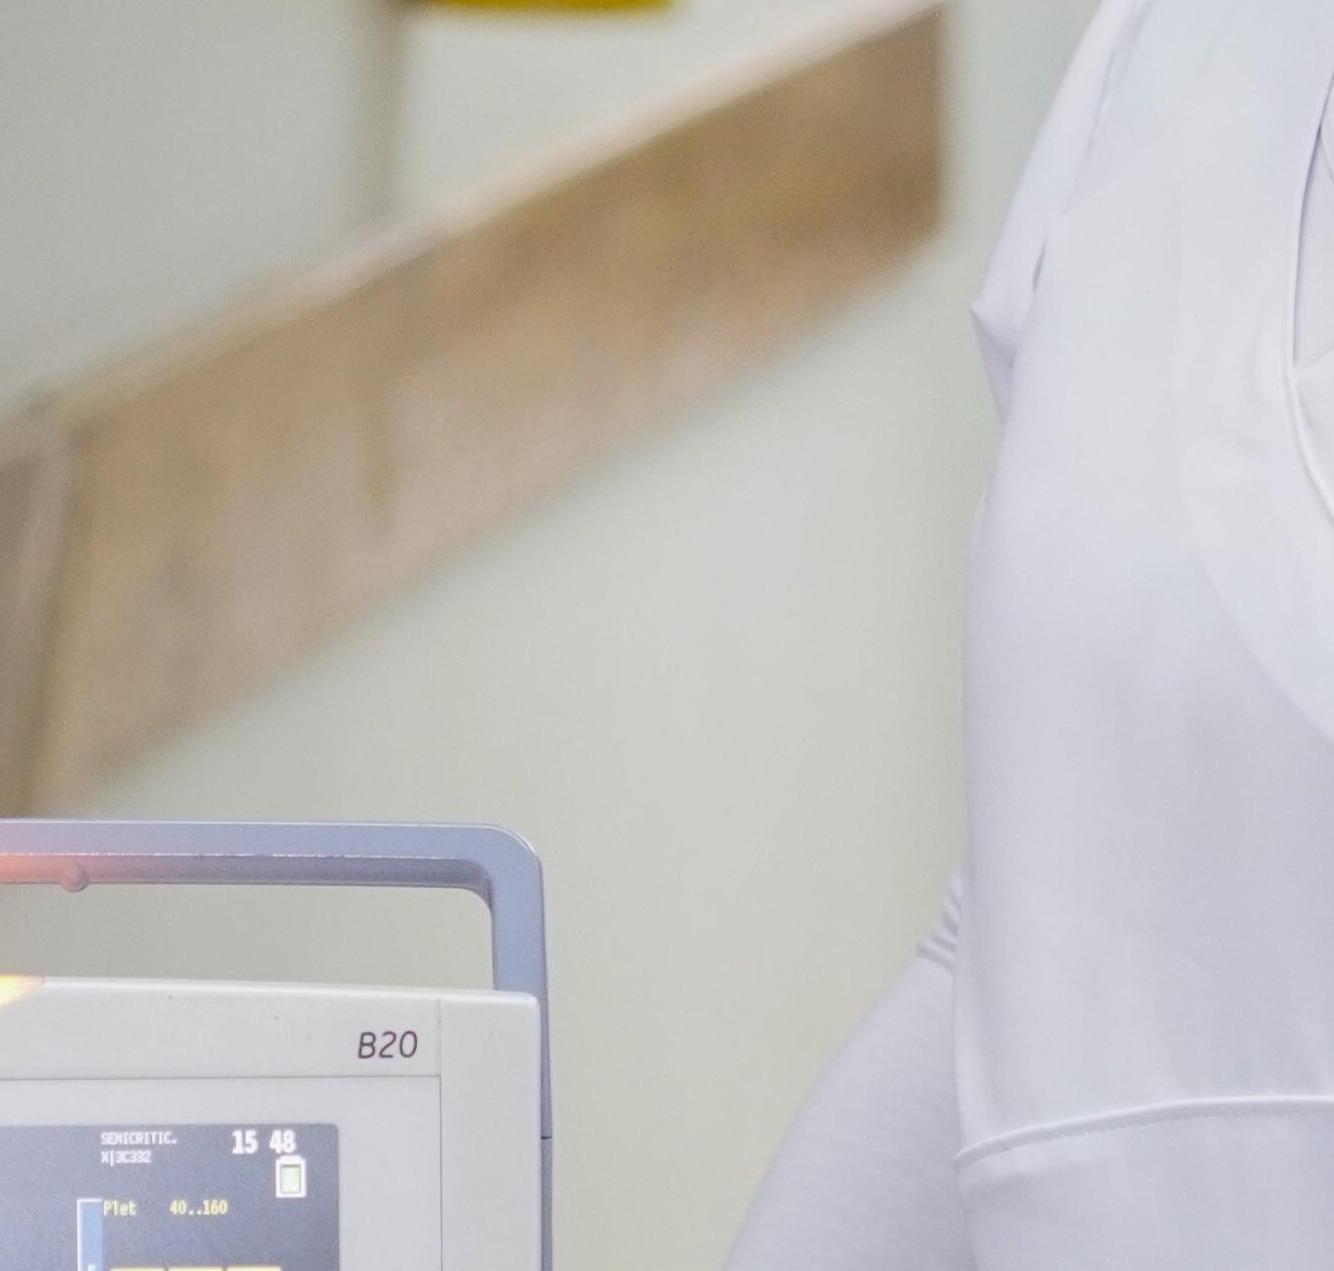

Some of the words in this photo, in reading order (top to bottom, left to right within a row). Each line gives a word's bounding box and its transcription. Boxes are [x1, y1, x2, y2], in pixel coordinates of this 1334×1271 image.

[358, 1030, 418, 1059] B20
[104, 1200, 137, 1216] Plet
[169, 1199, 228, 1216] 40..160
